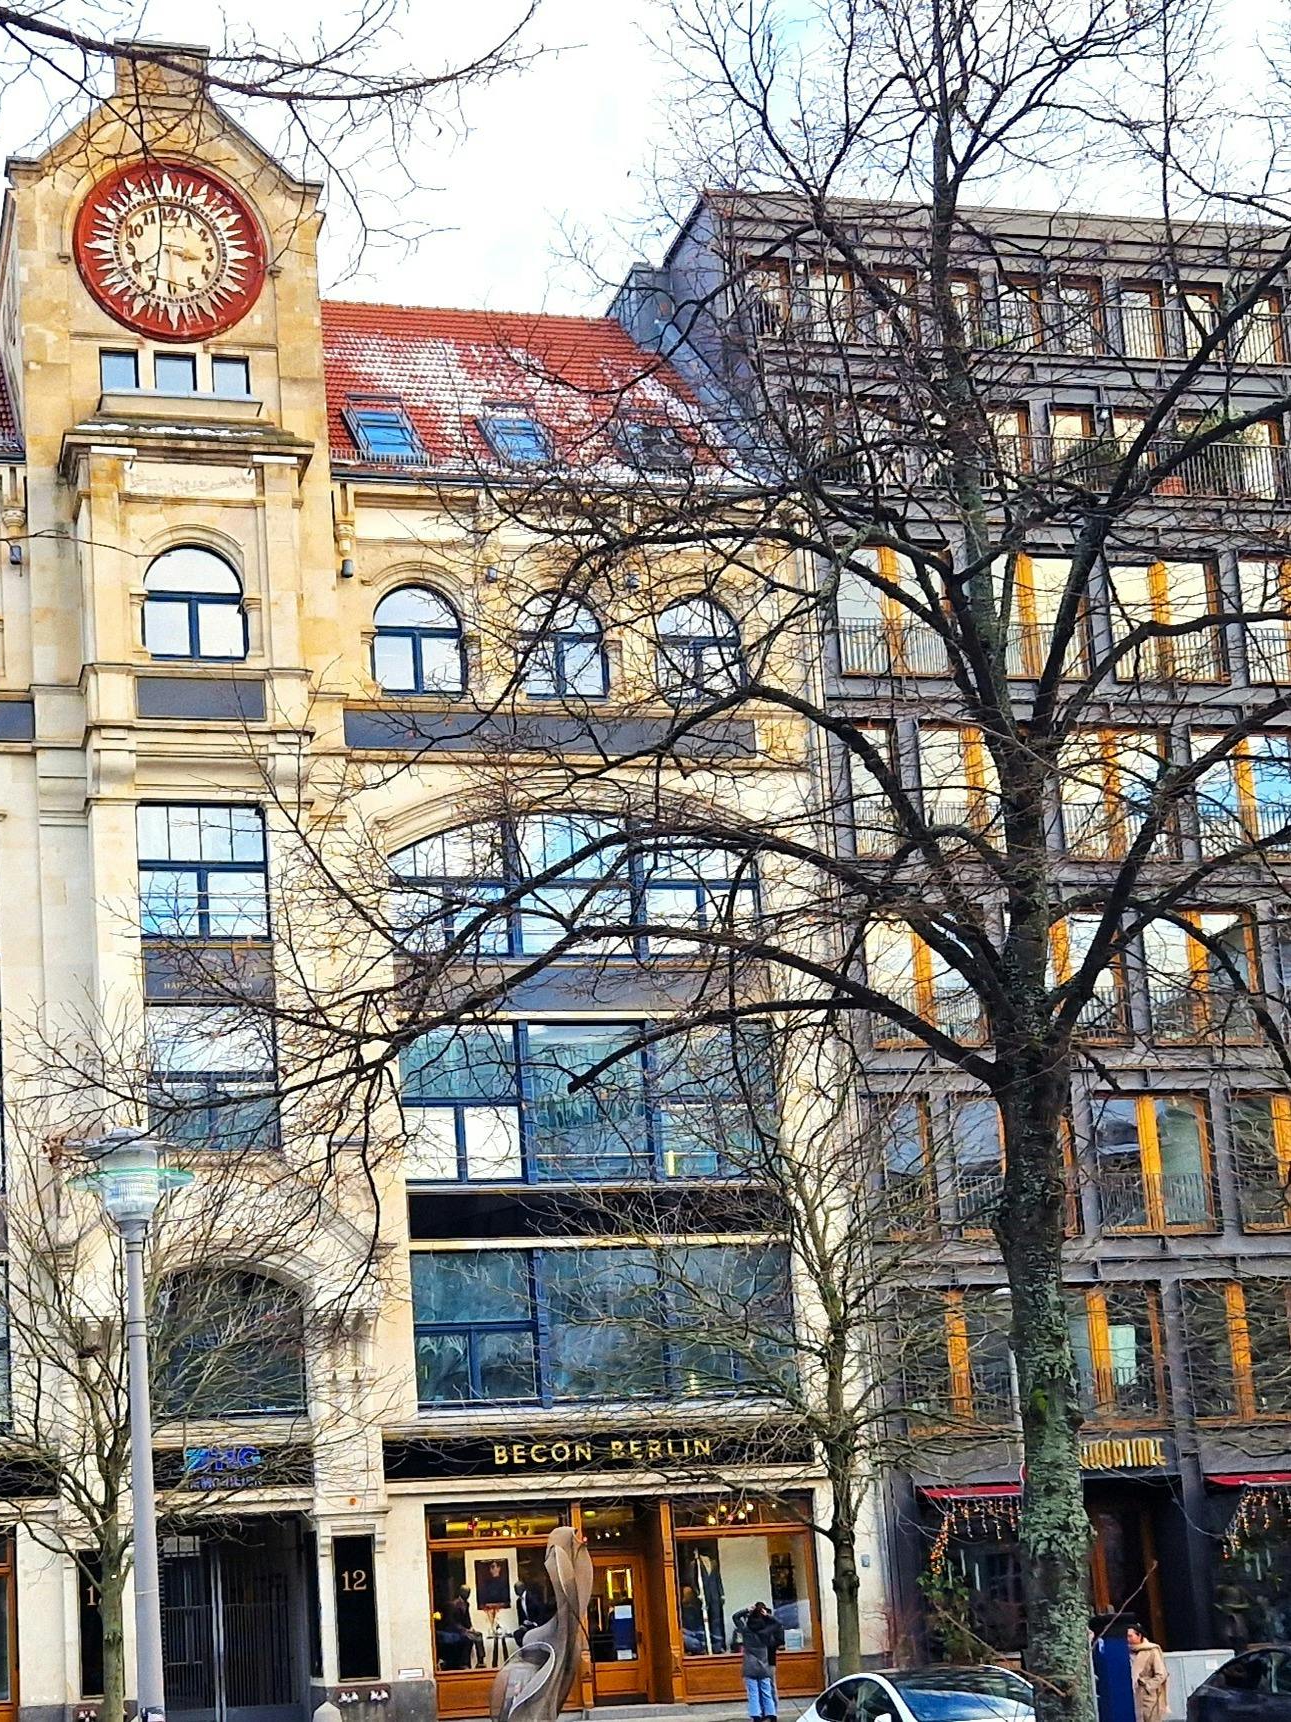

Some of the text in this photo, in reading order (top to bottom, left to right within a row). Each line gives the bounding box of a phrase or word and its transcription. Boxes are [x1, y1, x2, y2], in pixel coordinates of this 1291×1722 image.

[142, 210, 156, 226] 11
[161, 207, 177, 221] 12
[127, 223, 144, 239] 10
[494, 1438, 711, 1465] BECON BERLIN
[341, 1569, 367, 1591] 12
